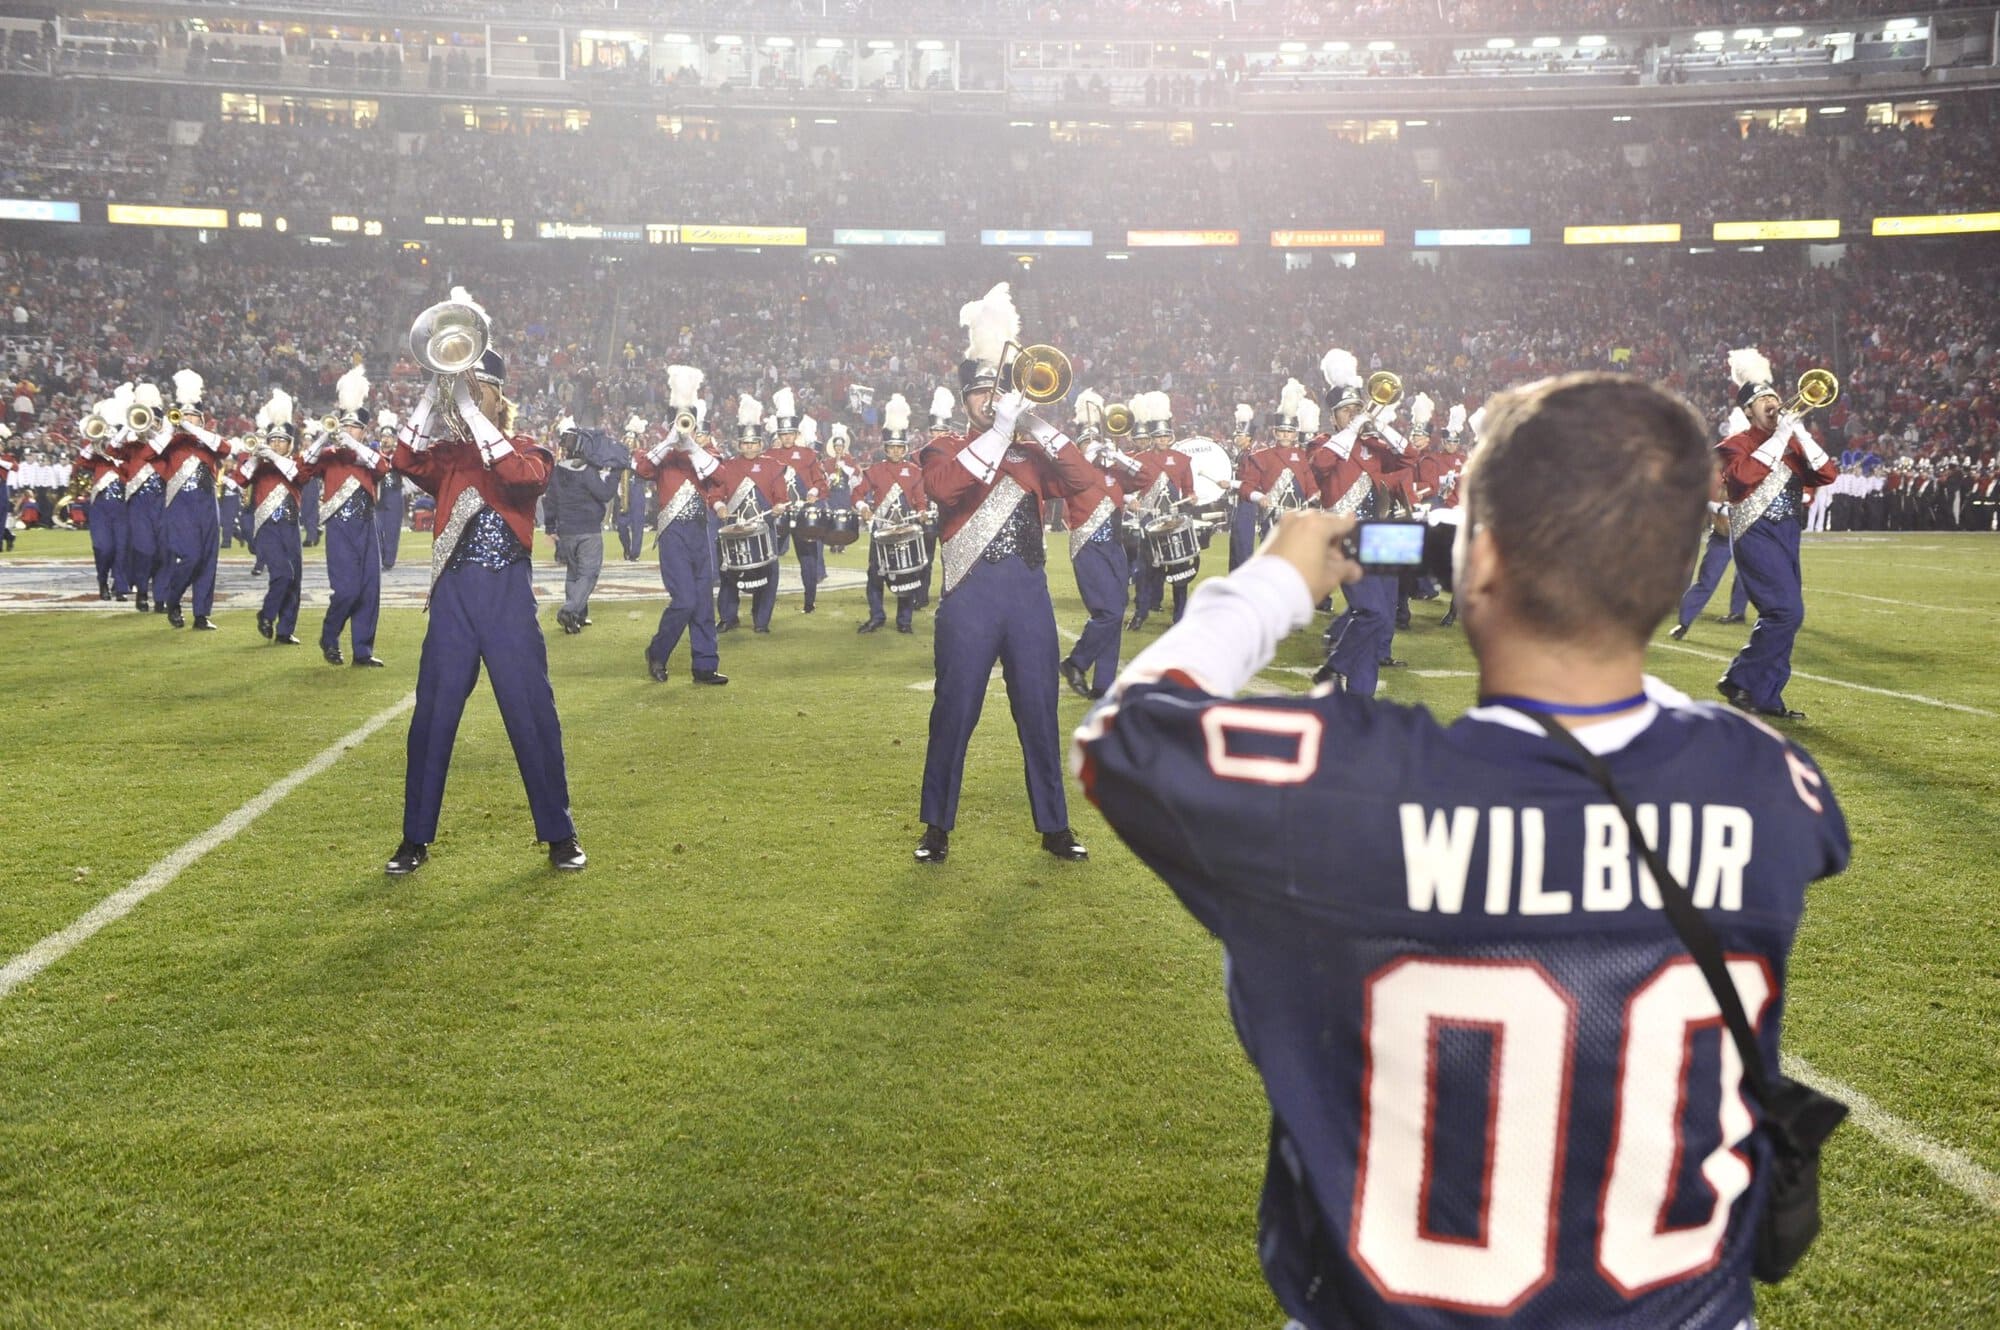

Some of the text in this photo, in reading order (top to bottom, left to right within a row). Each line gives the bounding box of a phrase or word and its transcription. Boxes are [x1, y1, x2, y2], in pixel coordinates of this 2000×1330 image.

[744, 576, 769, 589] YAMAHA
[897, 579, 922, 592] YAMAHA
[1400, 802, 1754, 916] WILBUR
[1350, 953, 1778, 1317] 00
